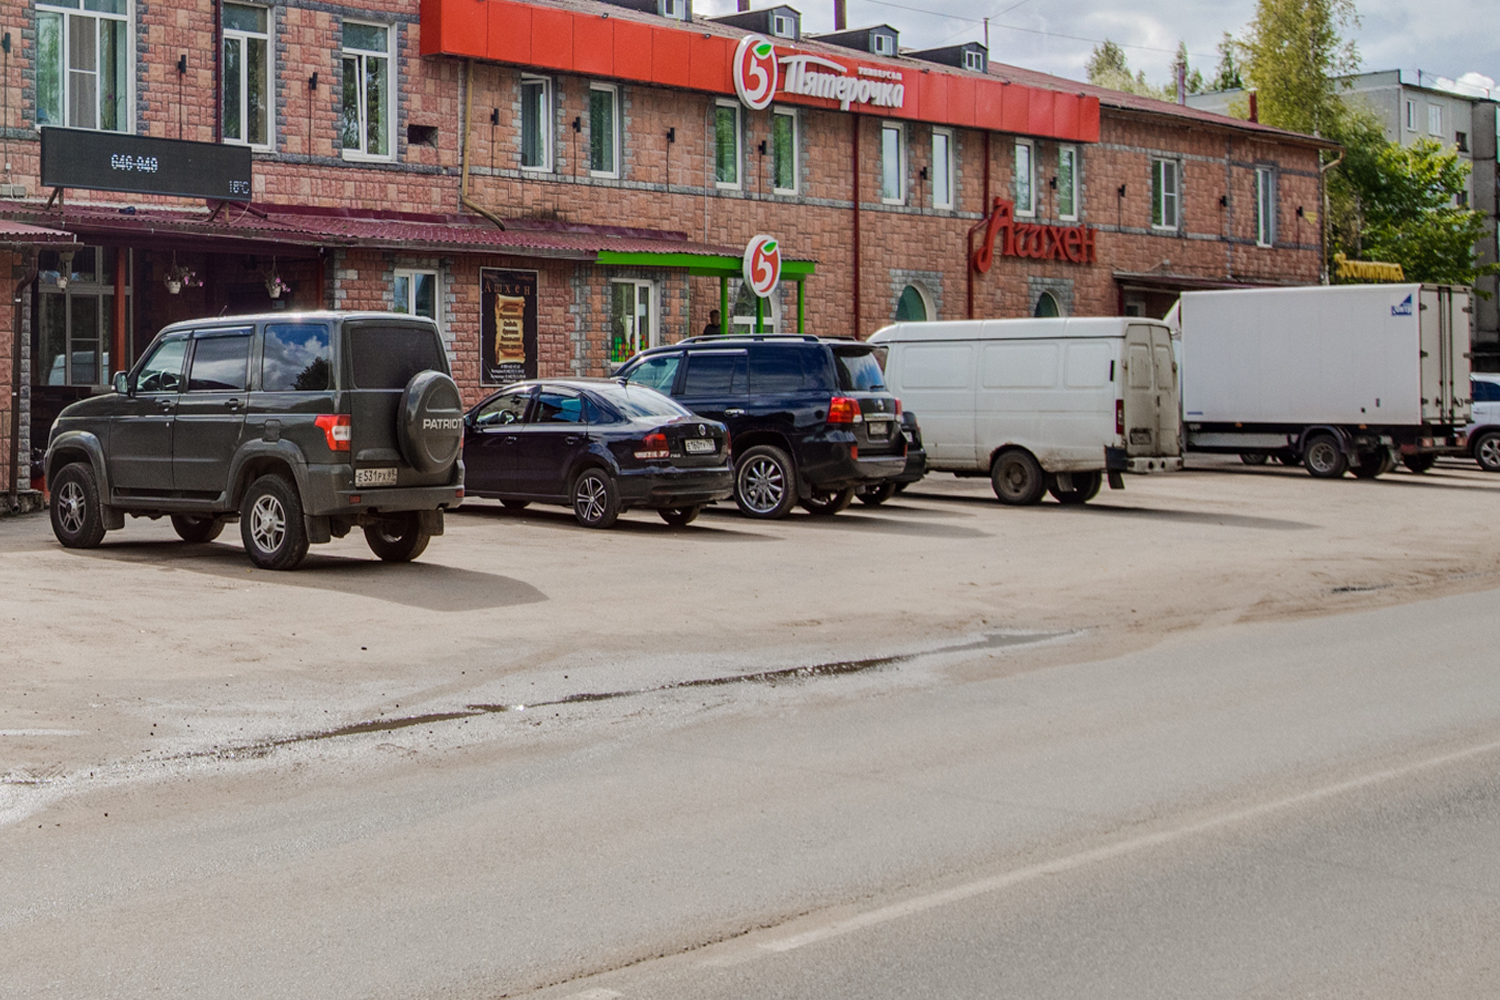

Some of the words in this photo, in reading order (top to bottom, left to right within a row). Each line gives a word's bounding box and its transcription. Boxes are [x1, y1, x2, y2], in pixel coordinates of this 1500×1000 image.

[972, 196, 1099, 273] Ашхен
[484, 281, 531, 295] Ашхен
[423, 418, 462, 430] PATRIOT
